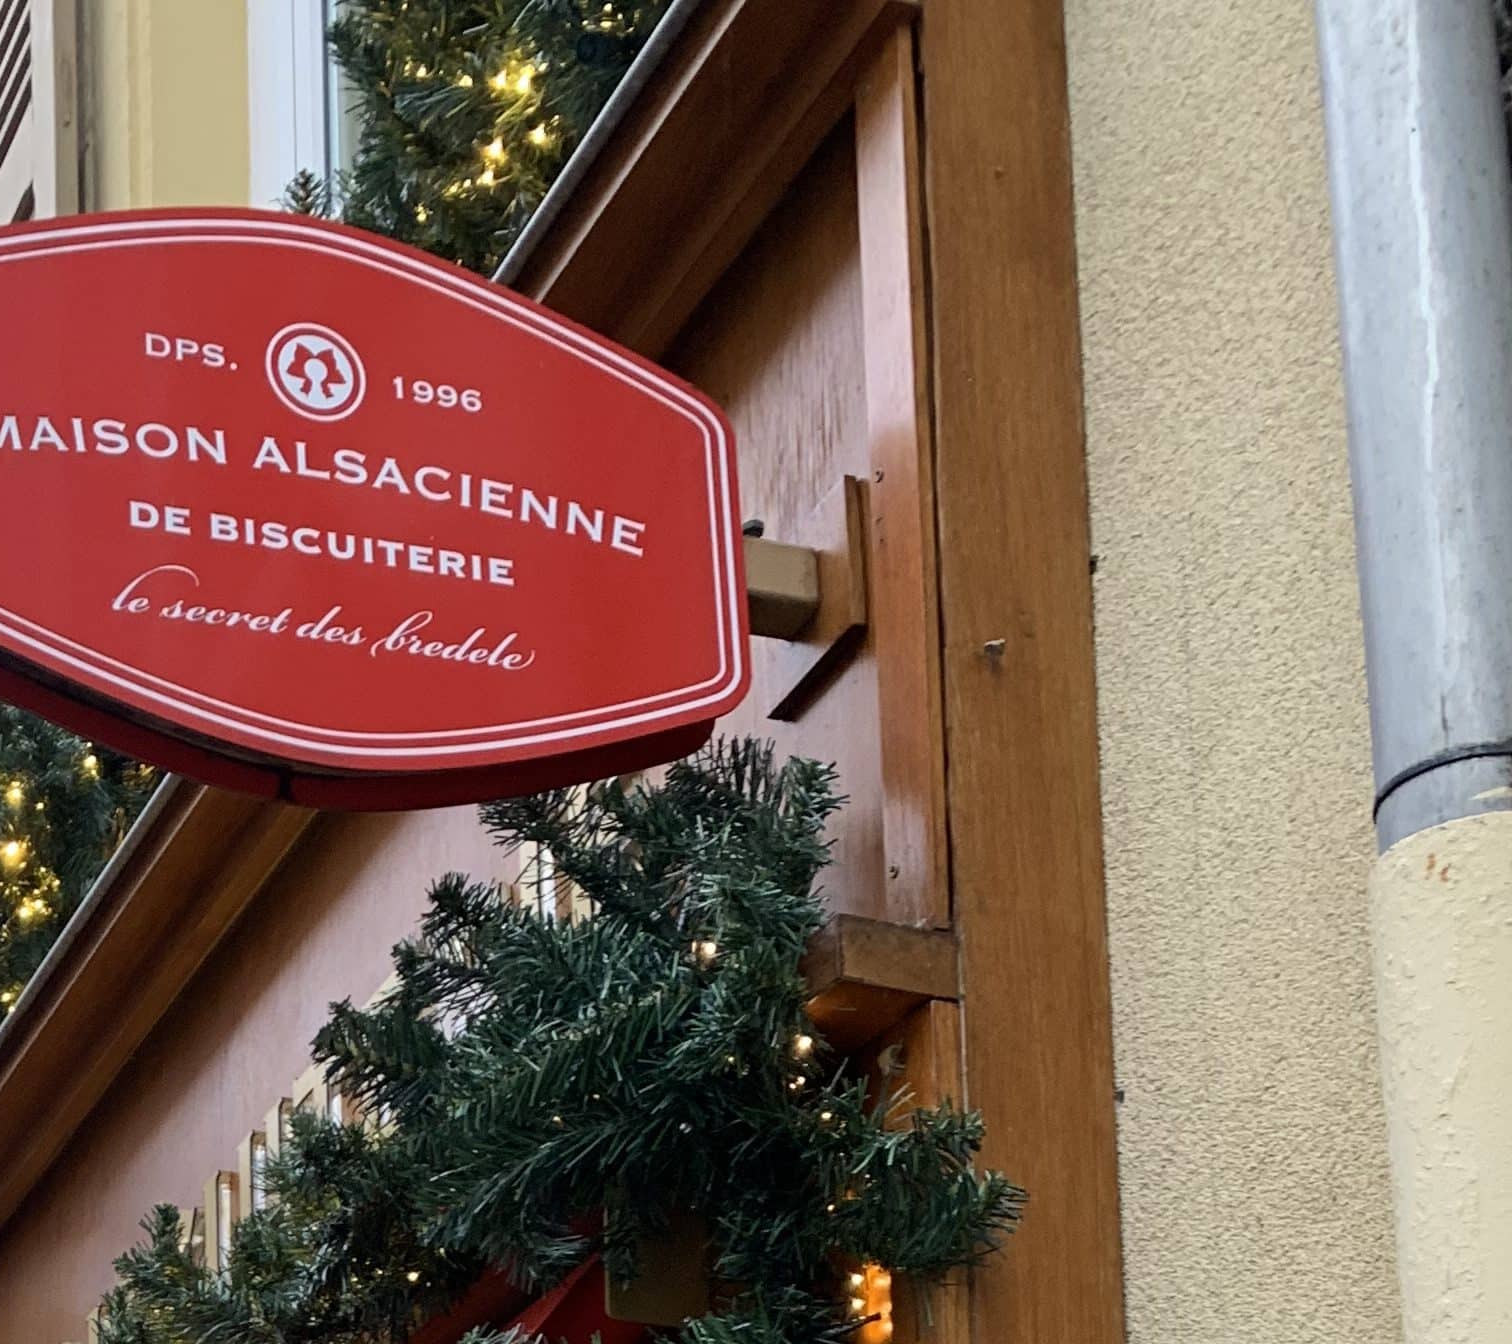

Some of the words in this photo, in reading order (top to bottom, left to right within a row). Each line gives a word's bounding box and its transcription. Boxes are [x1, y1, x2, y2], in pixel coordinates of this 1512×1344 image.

[143, 332, 239, 372] DPS.
[392, 375, 484, 413] 1996
[128, 499, 192, 537] DE
[208, 512, 516, 587] BISCUITERIE
[251, 435, 647, 558] ALSACIENNE
[111, 563, 200, 614] le
[159, 599, 293, 635] secret
[295, 605, 365, 646] des
[369, 610, 536, 671] bredele
